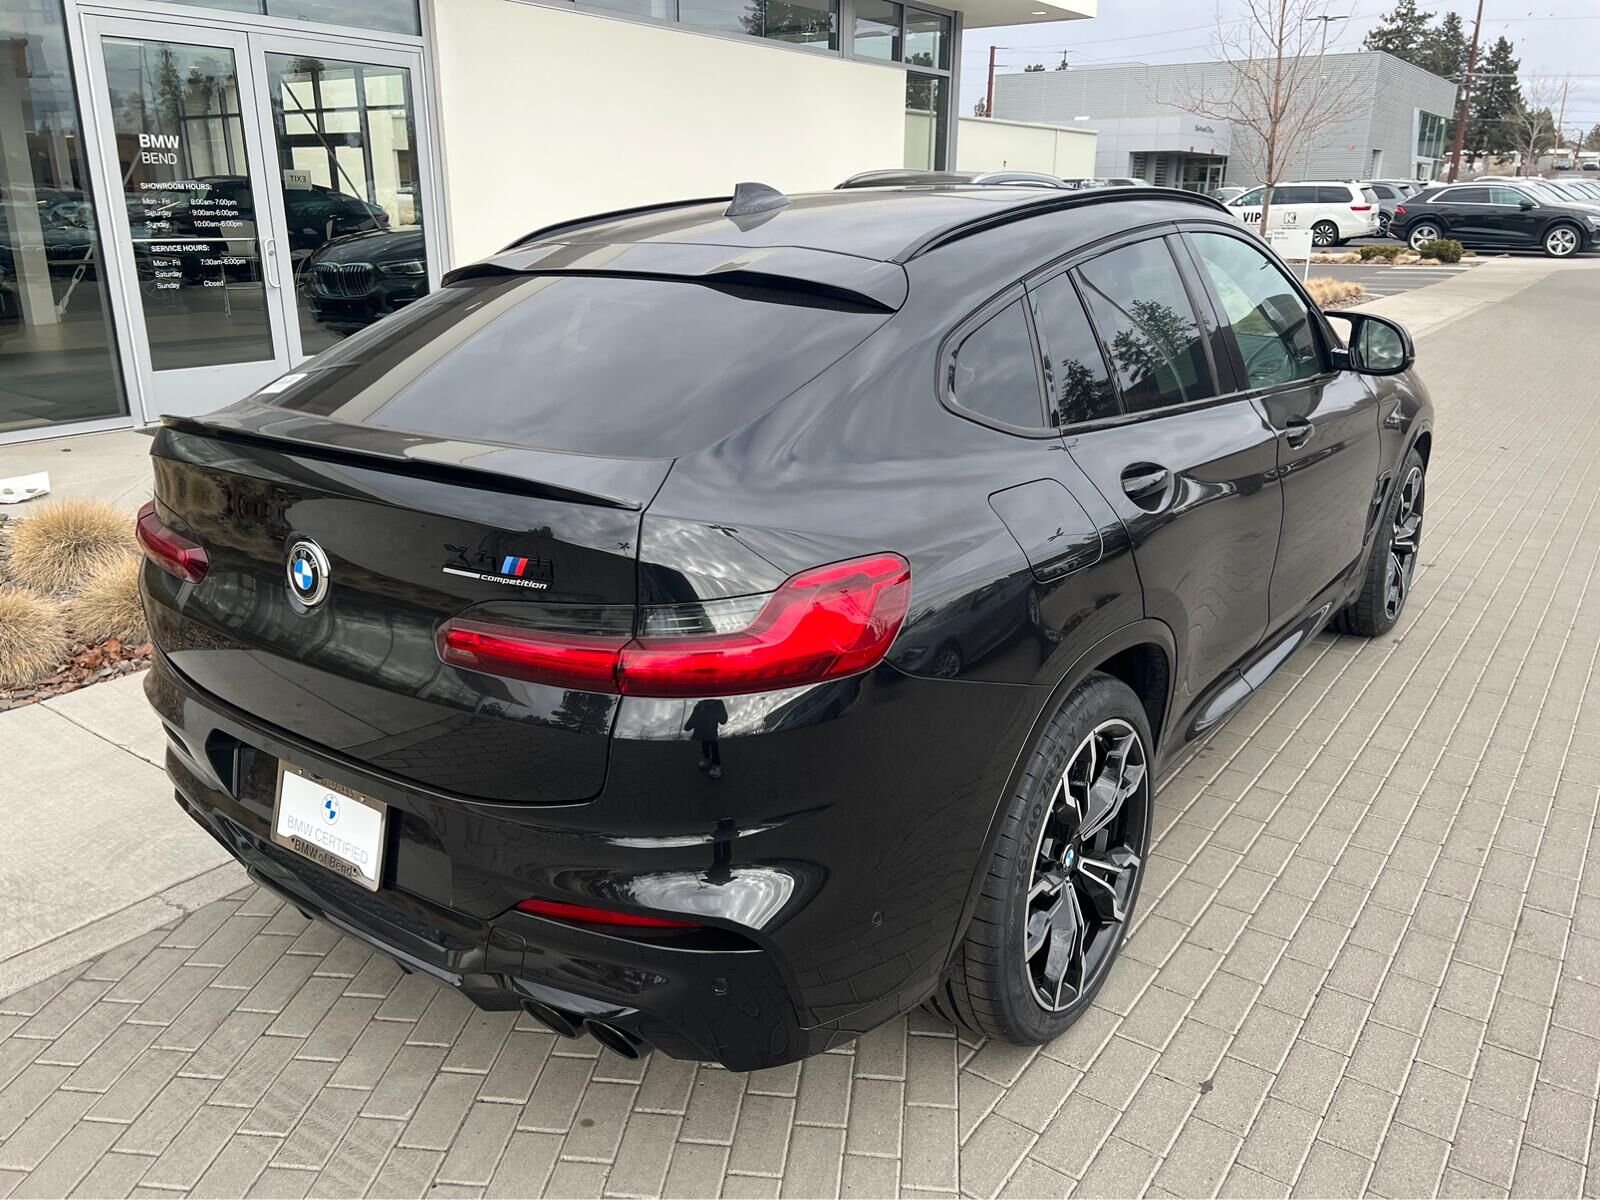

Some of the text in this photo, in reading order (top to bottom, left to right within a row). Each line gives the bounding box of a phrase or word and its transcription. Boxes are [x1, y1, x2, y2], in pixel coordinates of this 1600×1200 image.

[138, 134, 179, 149] BMW
[141, 152, 177, 165] BEND
[140, 182, 185, 190] SHOWROOM
[144, 209, 172, 218] Saturday
[1243, 211, 1262, 223] VIP
[146, 221, 170, 229] Sunday
[183, 244, 210, 252] HOURS:
[155, 270, 182, 279] Saturday
[157, 282, 180, 290] Sunday
[480, 574, 548, 590] competition
[287, 815, 369, 865] BMW CERTIFIED
[294, 840, 353, 877] BMW of Bend
